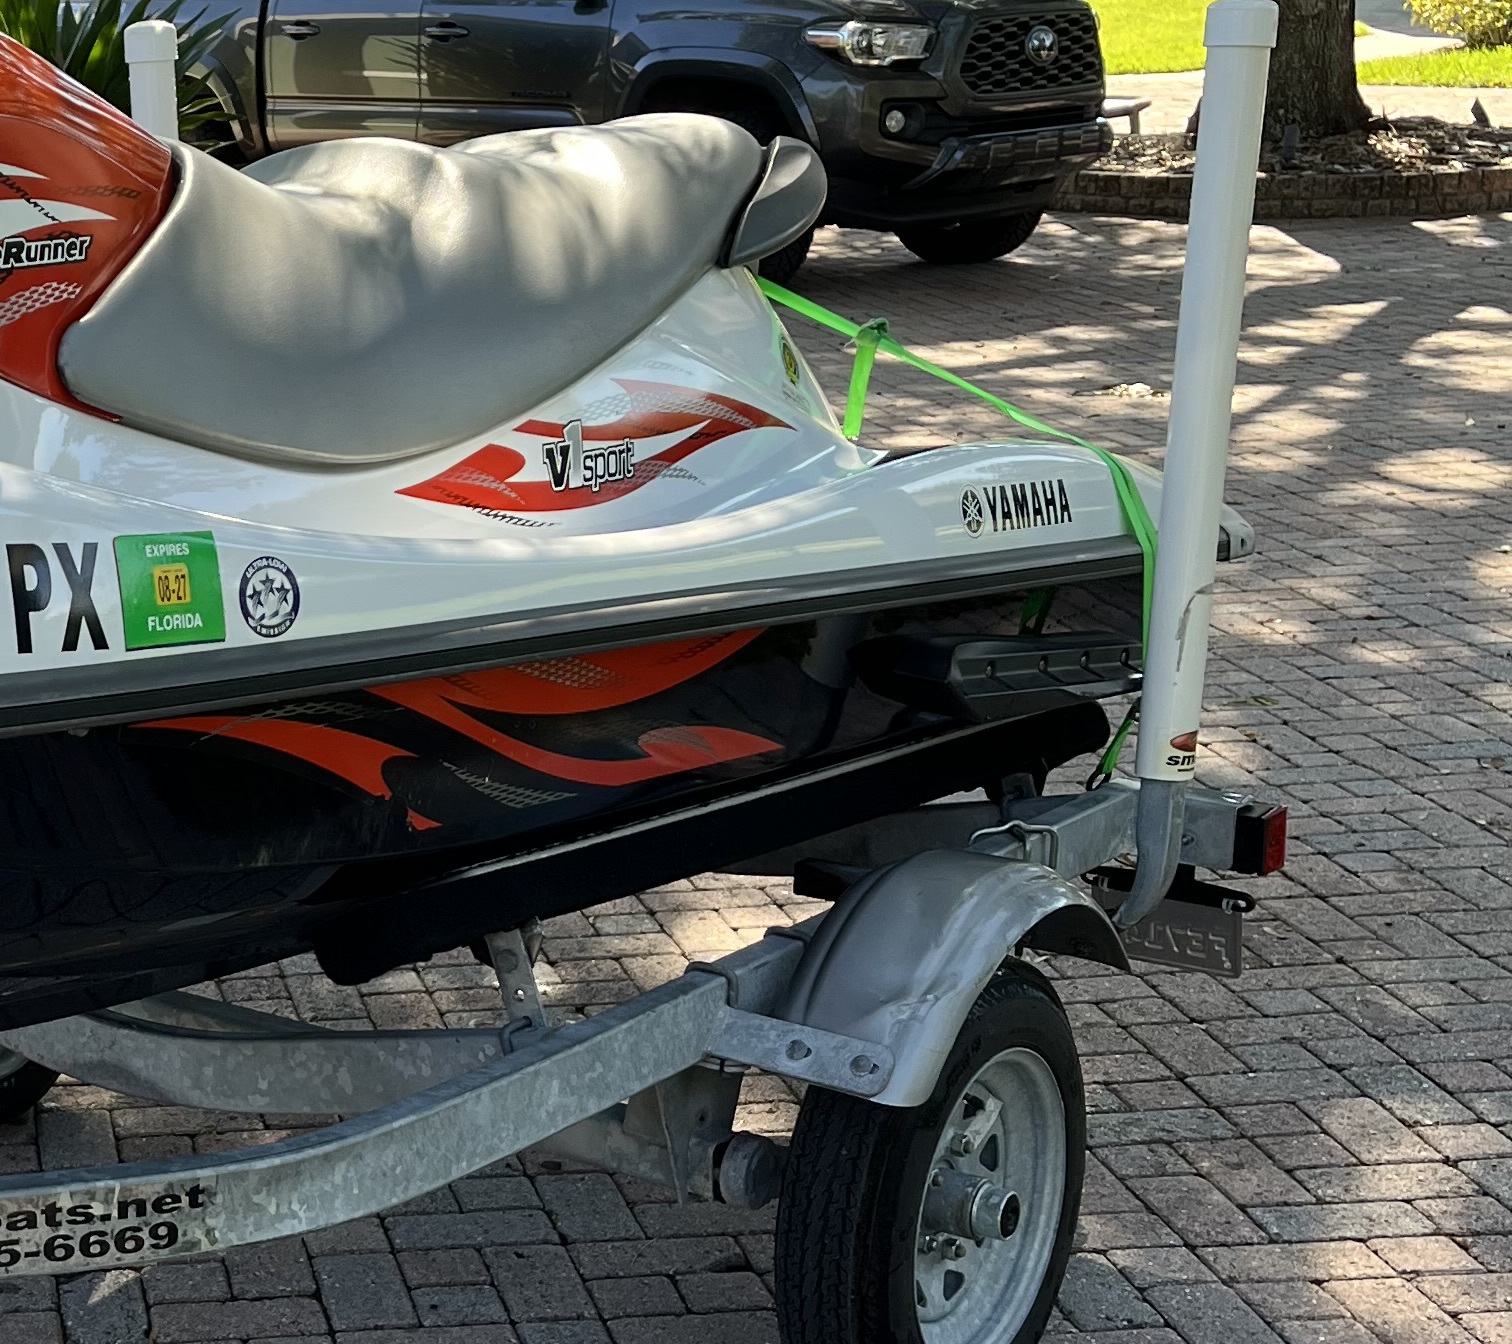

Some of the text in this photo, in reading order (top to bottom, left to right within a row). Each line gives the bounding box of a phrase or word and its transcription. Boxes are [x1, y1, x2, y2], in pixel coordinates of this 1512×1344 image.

[983, 478, 1073, 532] YAMAHA
[145, 542, 190, 558] EXPIRES
[6, 542, 109, 654] PX
[147, 612, 204, 632] FLORIDA
